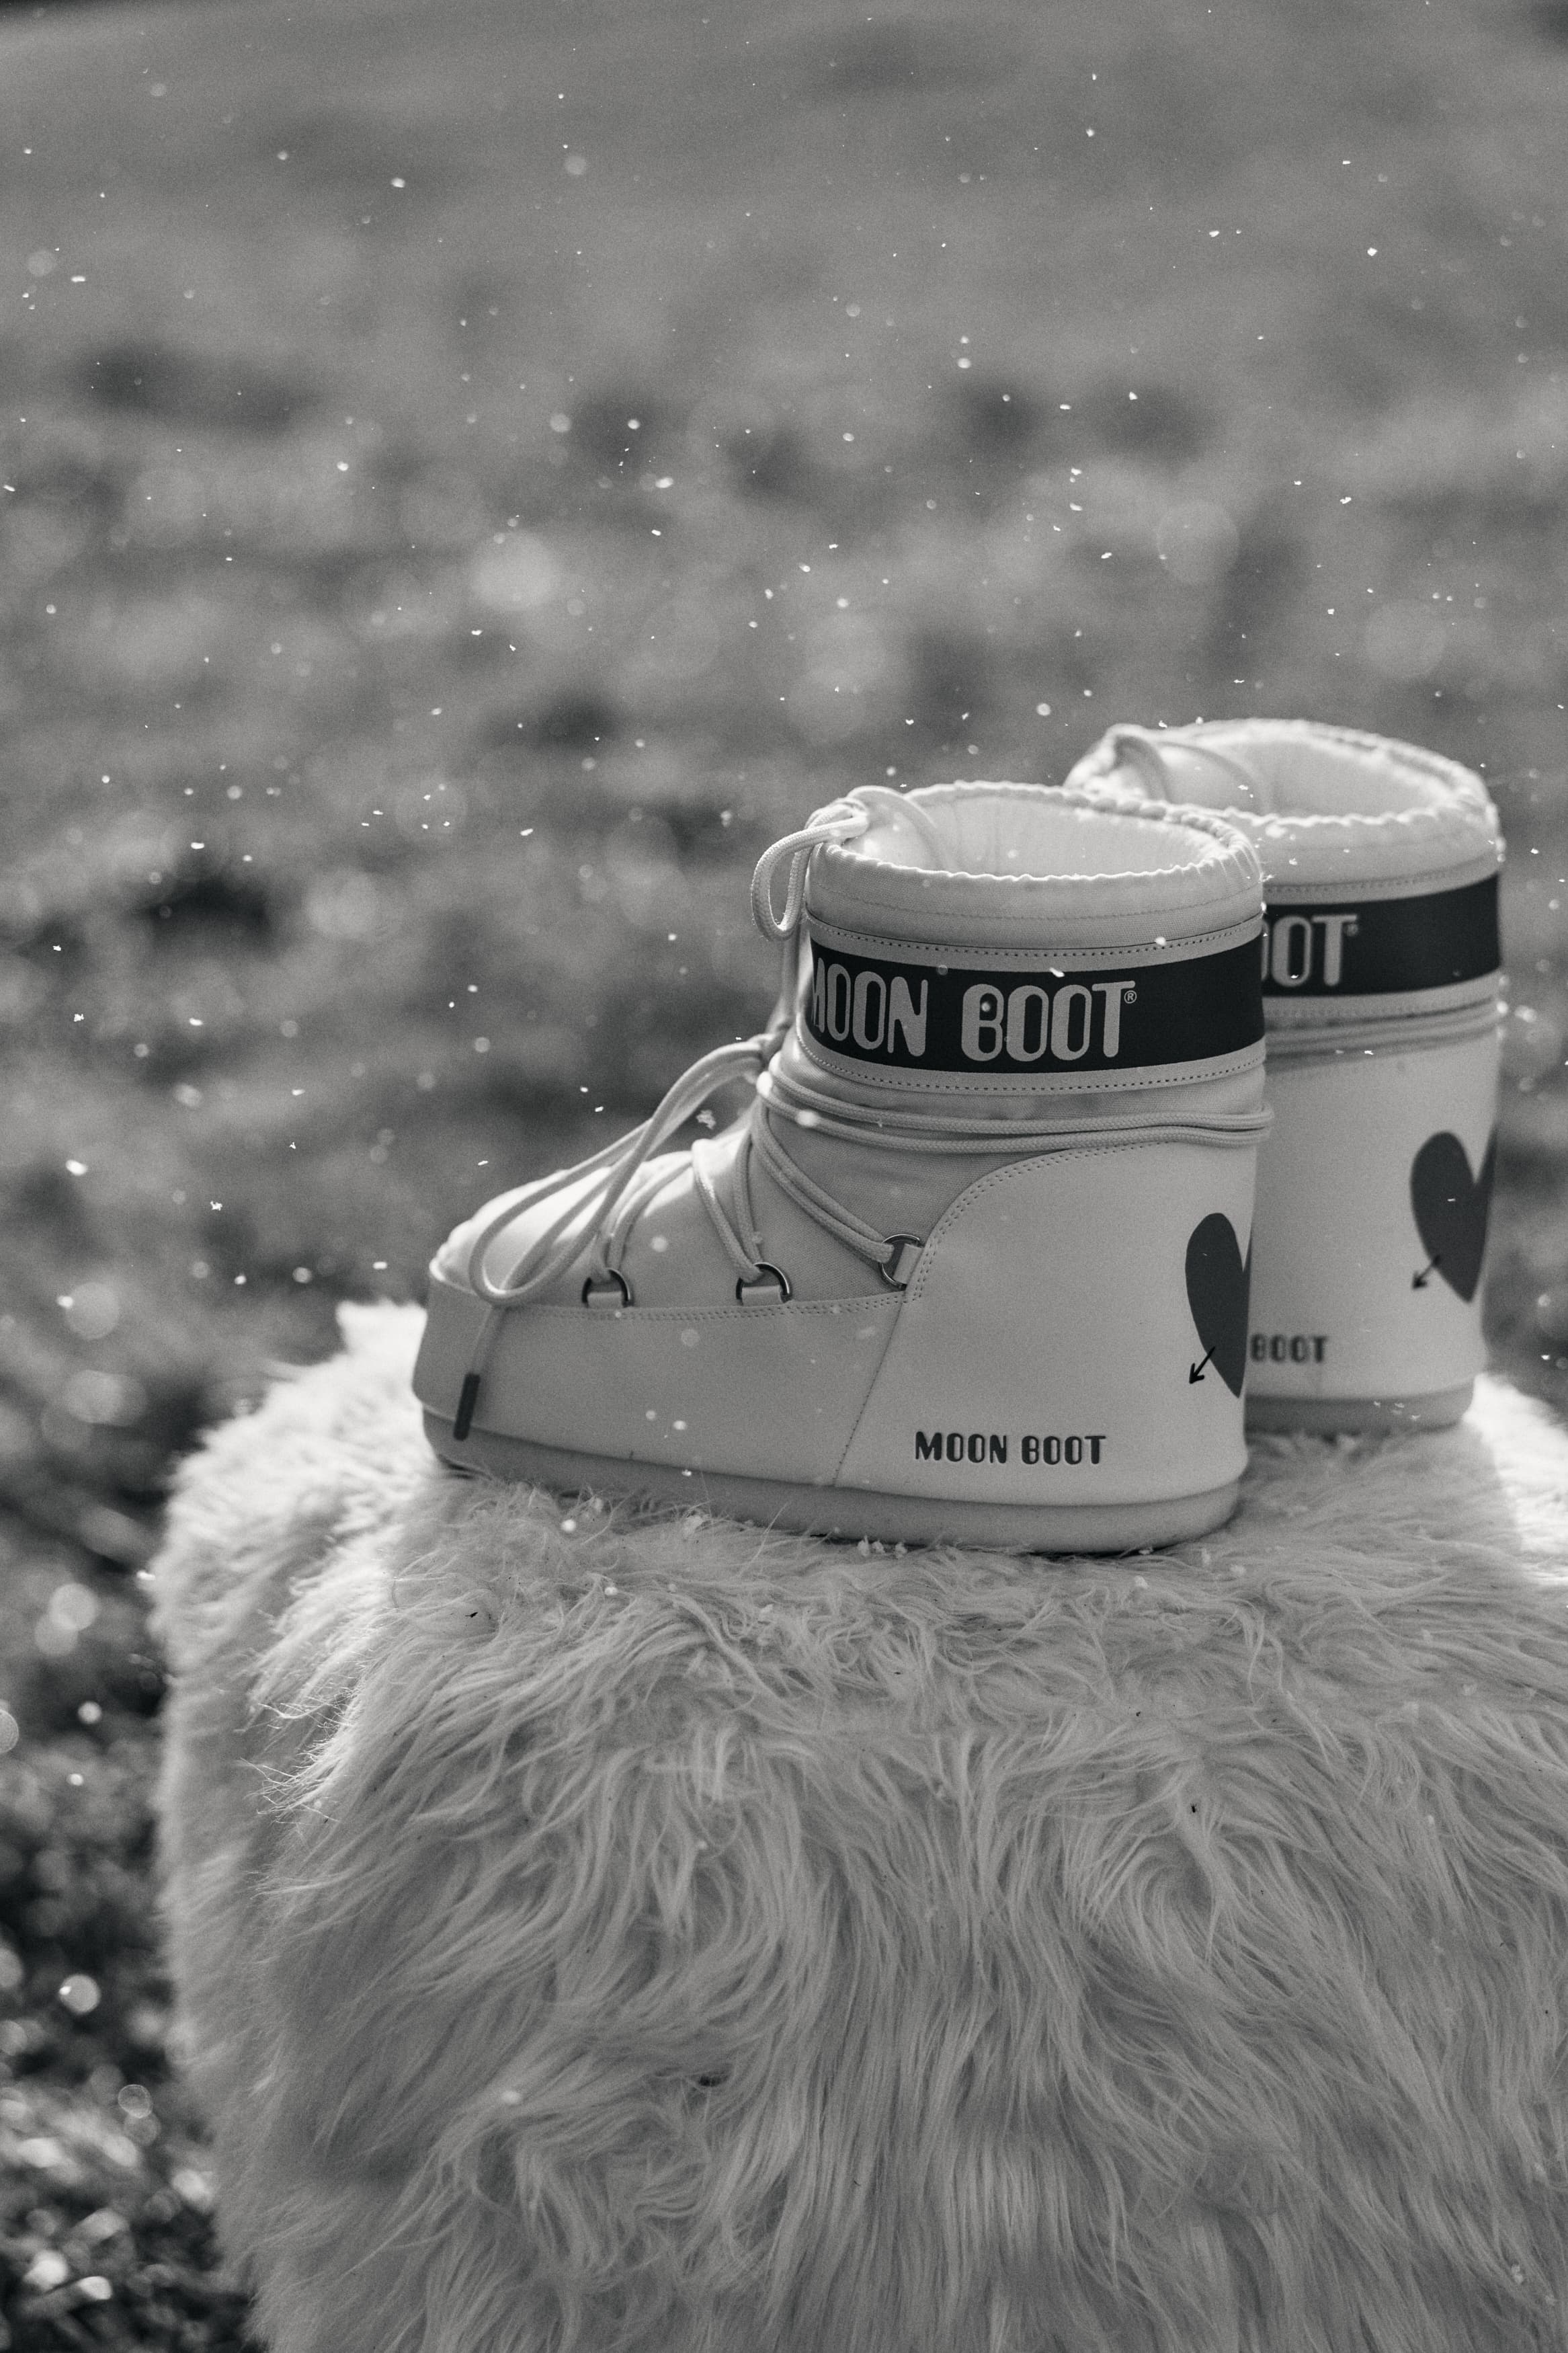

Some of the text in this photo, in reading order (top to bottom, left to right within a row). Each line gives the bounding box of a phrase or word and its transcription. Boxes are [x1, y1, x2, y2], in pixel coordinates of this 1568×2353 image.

[1261, 914, 1358, 988] OT
[1249, 1333, 1329, 1364] BOOT
[915, 1431, 1107, 1465] MOON BOOT
